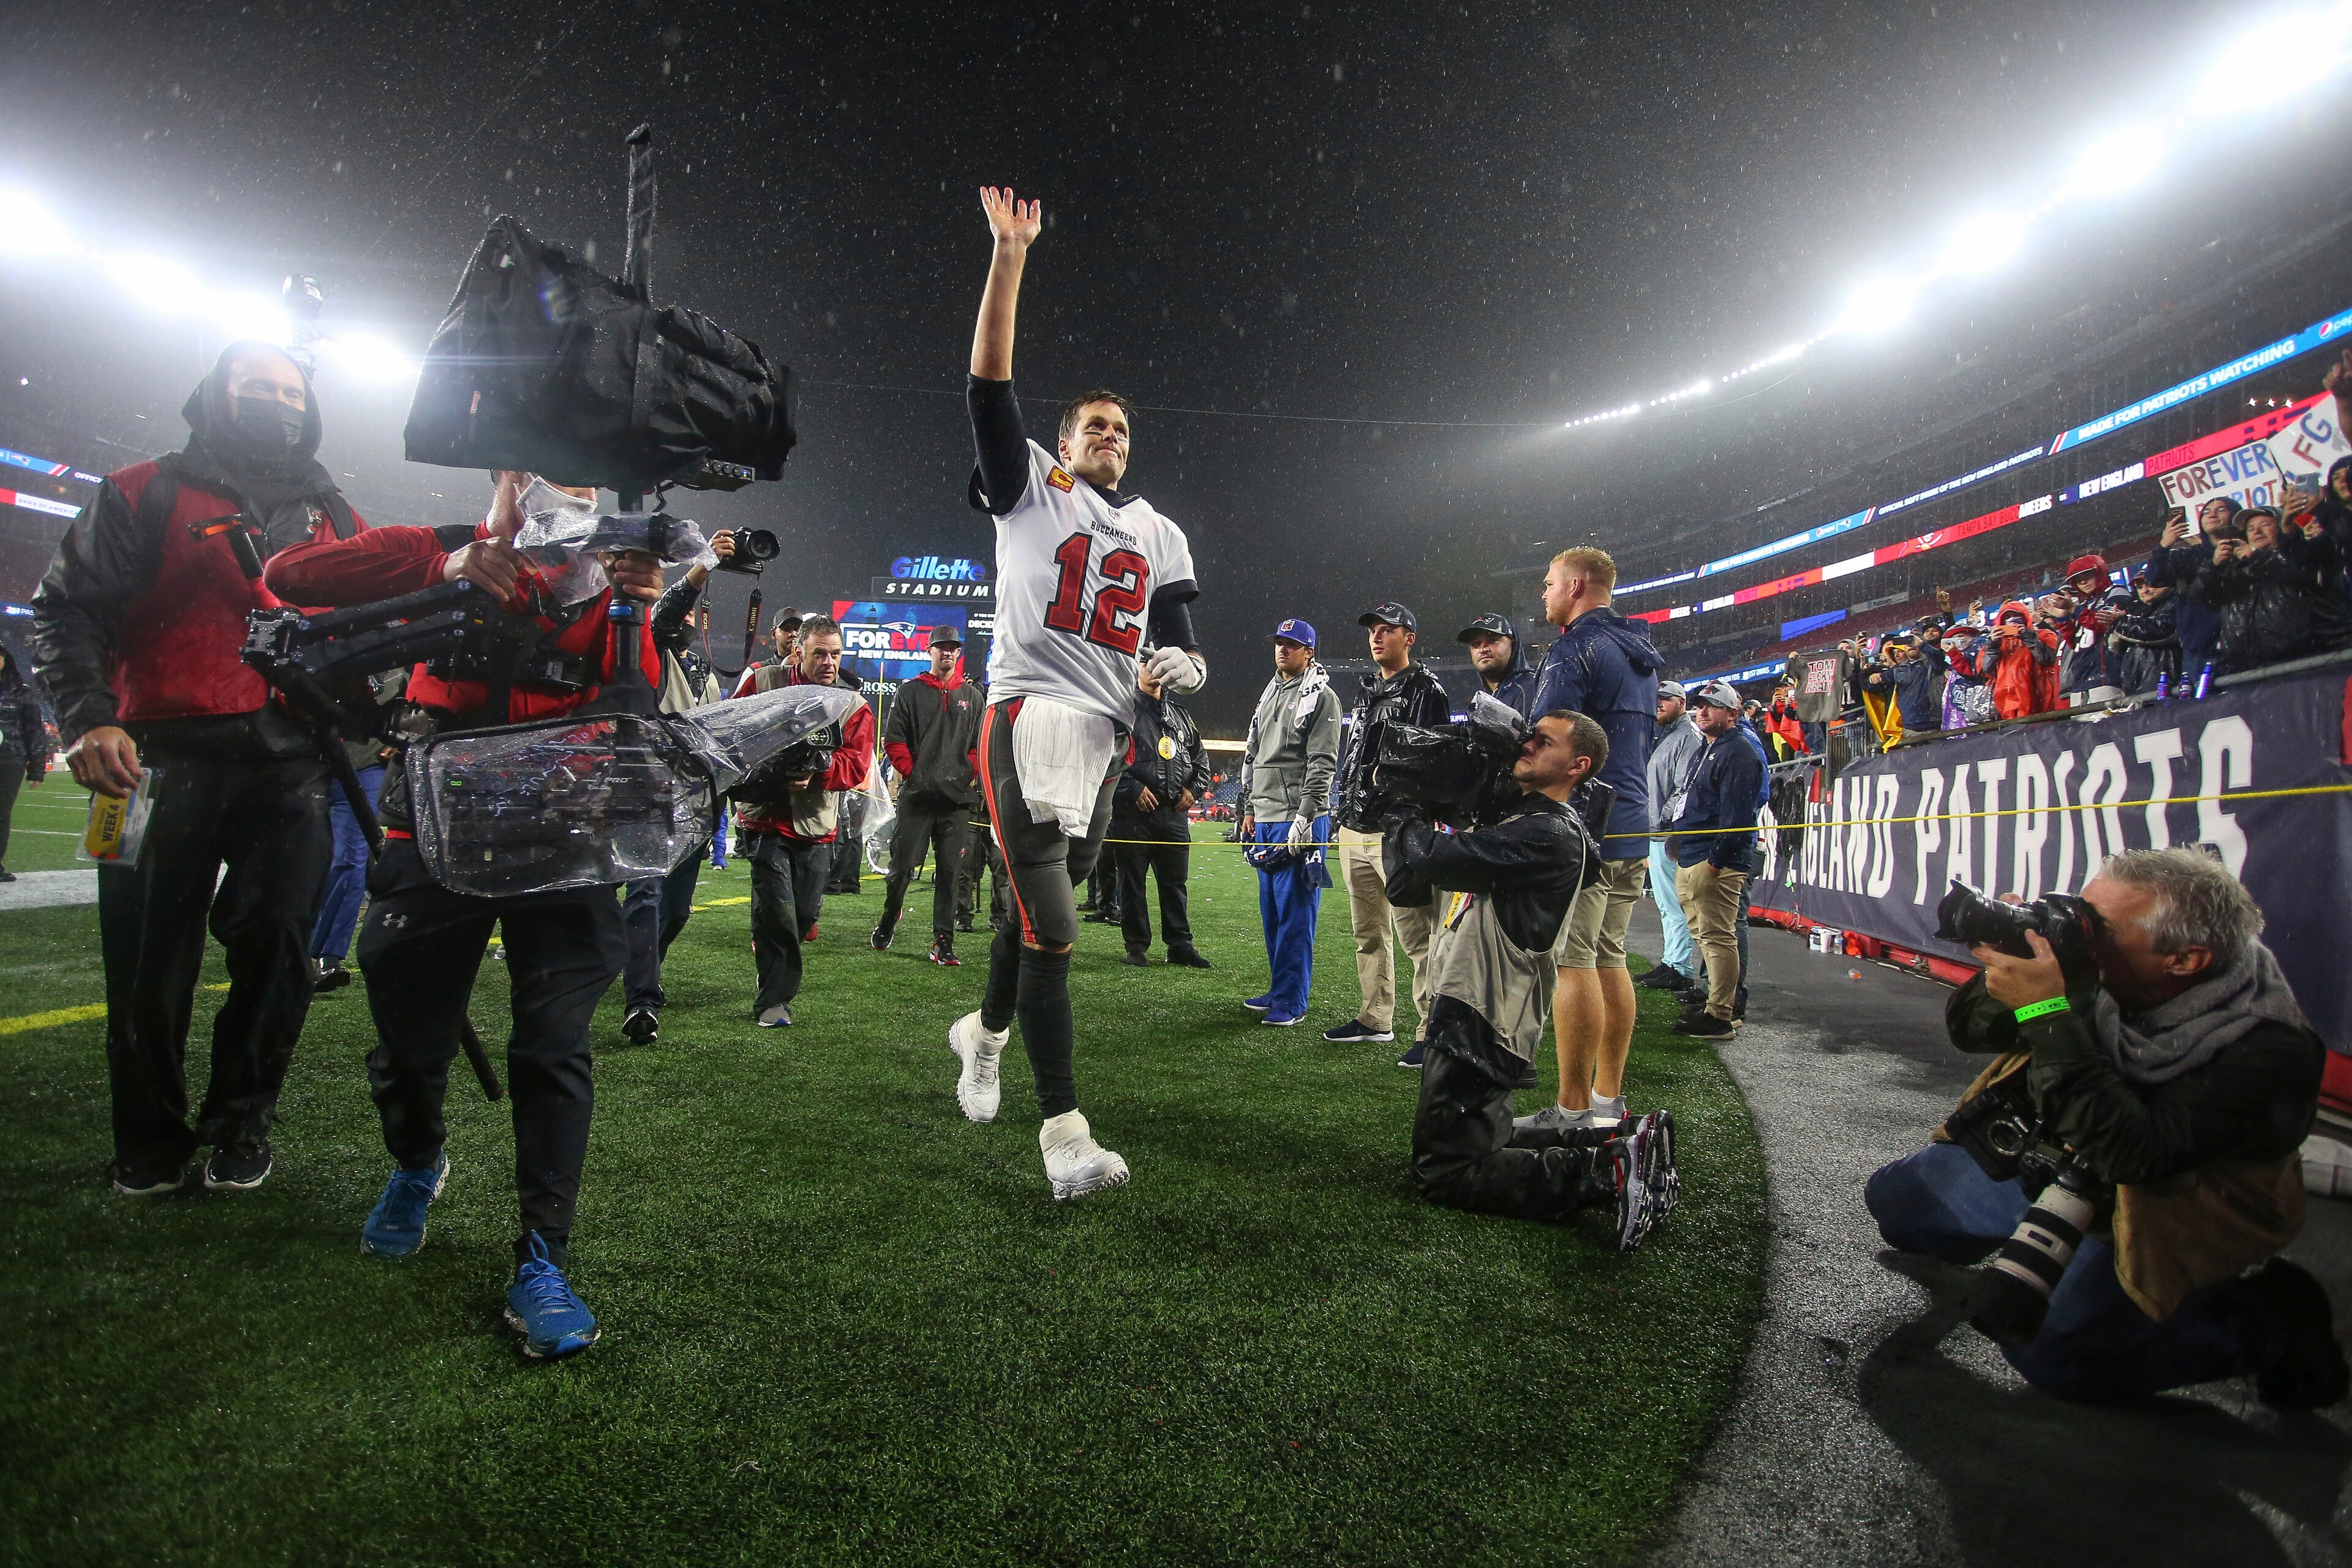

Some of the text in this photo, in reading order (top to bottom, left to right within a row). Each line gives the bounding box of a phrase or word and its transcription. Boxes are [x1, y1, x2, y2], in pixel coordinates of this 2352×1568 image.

[2078, 339, 2296, 440] MADE FOR PATRIOTS WATCHING
[1878, 500, 1904, 515] OFFICIAL
[1904, 494, 1920, 507] SOFT
[1939, 483, 1948, 493] OF
[1961, 472, 1977, 484] NEW
[1977, 460, 2008, 479] ENGLAND
[2008, 446, 2043, 466] PATRIOTS
[2079, 444, 2195, 499] NEW ENGLAND PATRIOTS
[2160, 442, 2275, 505] FOREVER
[1090, 521, 1137, 546] BUCCANEERS
[1958, 521, 1981, 538] TAMPA
[1983, 515, 2000, 530] BAY
[891, 556, 986, 581] Gillette
[885, 582, 990, 597] STADIUM
[1043, 532, 1150, 658] 12
[748, 607, 758, 631] Canon
[858, 649, 883, 659] NEW
[1807, 659, 1836, 673] TOM
[1786, 774, 1899, 899] NGLAND
[1913, 715, 2253, 905] PATRIOTS
[102, 812, 118, 842] WEEK
